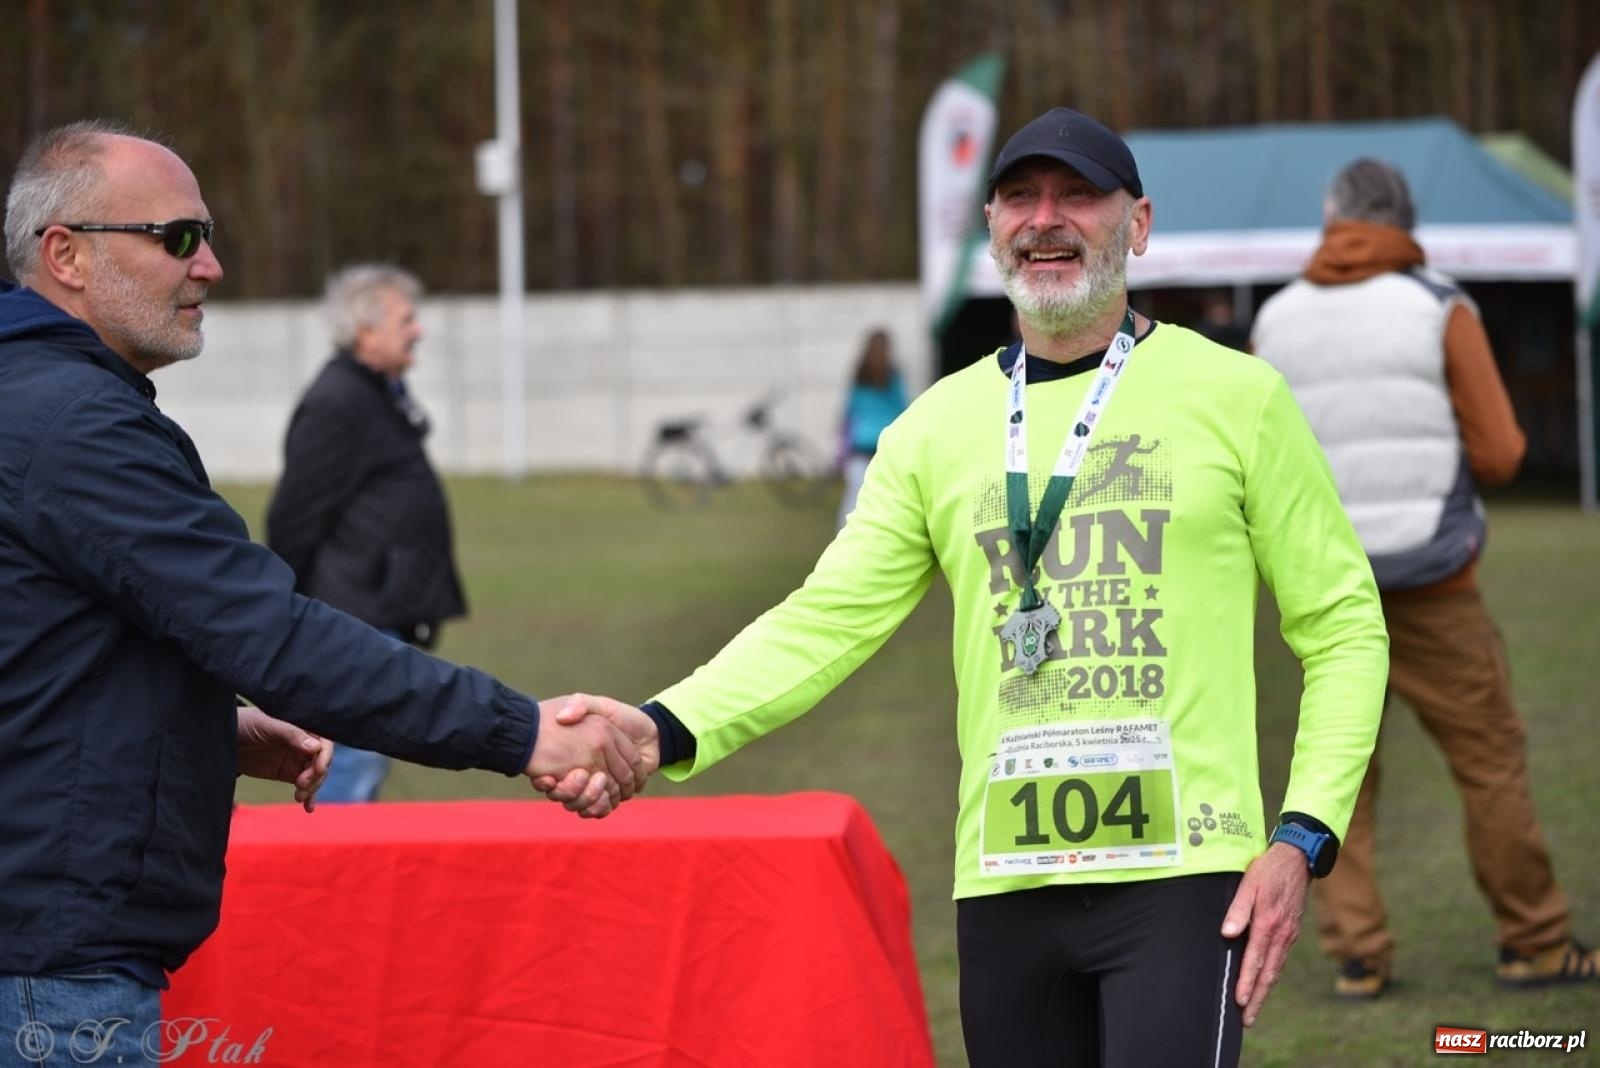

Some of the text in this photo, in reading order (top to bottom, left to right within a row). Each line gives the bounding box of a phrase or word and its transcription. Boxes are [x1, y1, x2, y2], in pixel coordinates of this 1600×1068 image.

[975, 509, 1170, 595] RUN
[1058, 579, 1130, 609] THE
[1067, 663, 1164, 700] 2018
[1042, 727, 1090, 737] Półmaraton
[1090, 725, 1114, 734] Leśny
[1116, 723, 1158, 733] RAFAMET
[1082, 737, 1118, 745] kwietnia
[1010, 776, 1149, 846] 104
